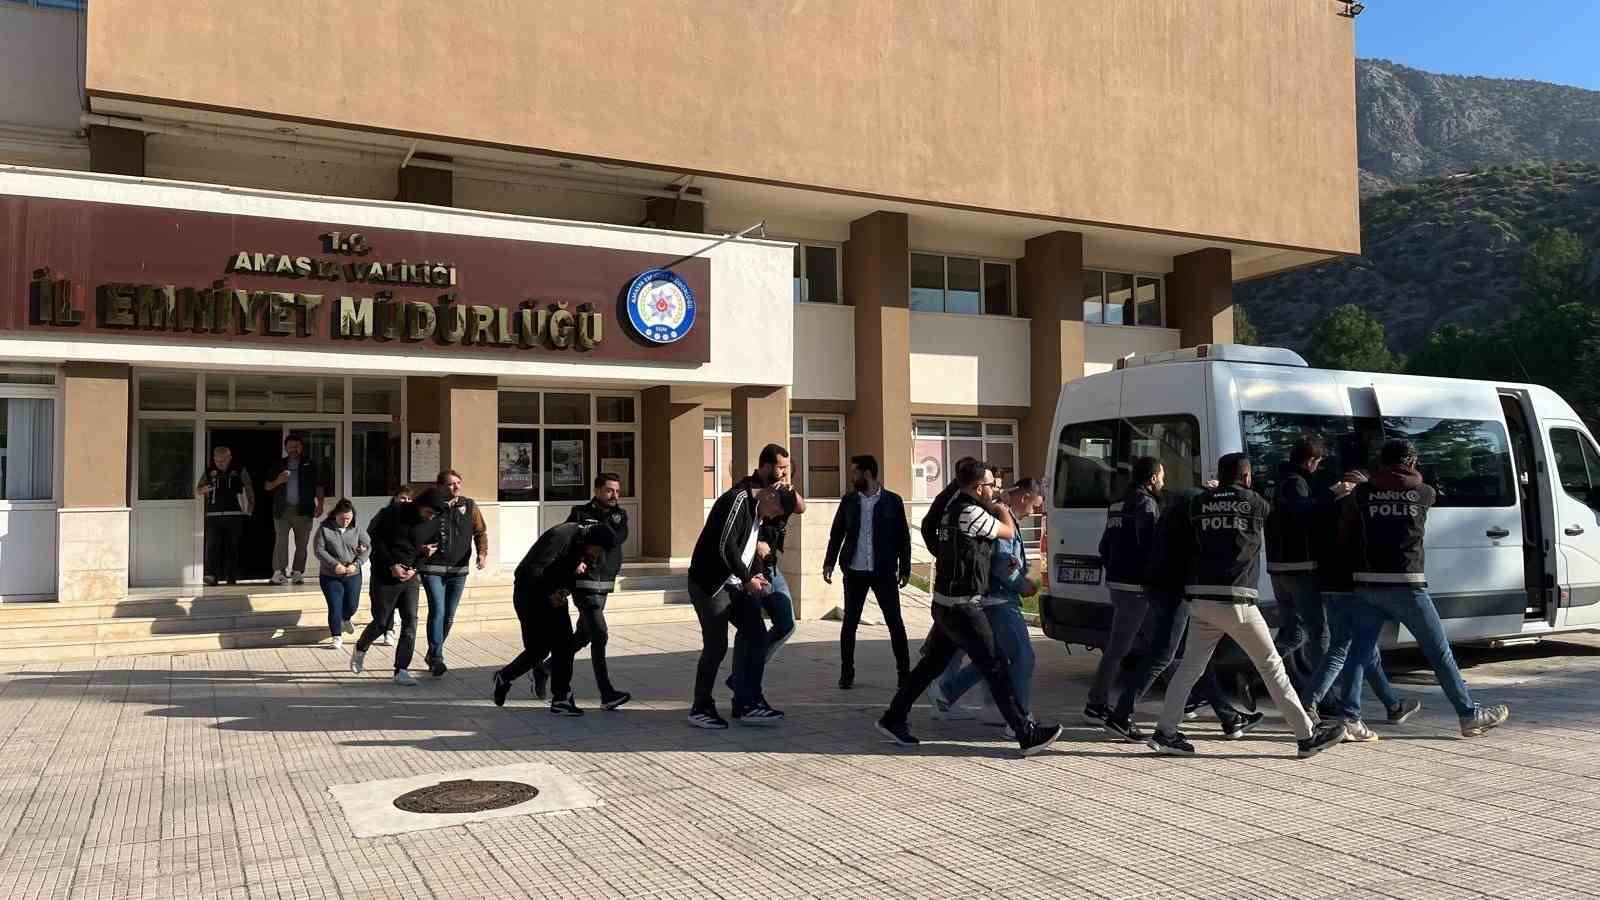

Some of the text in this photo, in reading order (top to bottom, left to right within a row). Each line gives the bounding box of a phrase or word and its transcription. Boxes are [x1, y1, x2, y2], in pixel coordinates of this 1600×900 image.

[30, 267, 85, 326] İL
[97, 279, 324, 337] EMNİYET
[334, 290, 602, 349] MÜDÜRLÜĞÜ
[1368, 503, 1418, 518] POLİS
[1201, 516, 1249, 531] POLİS
